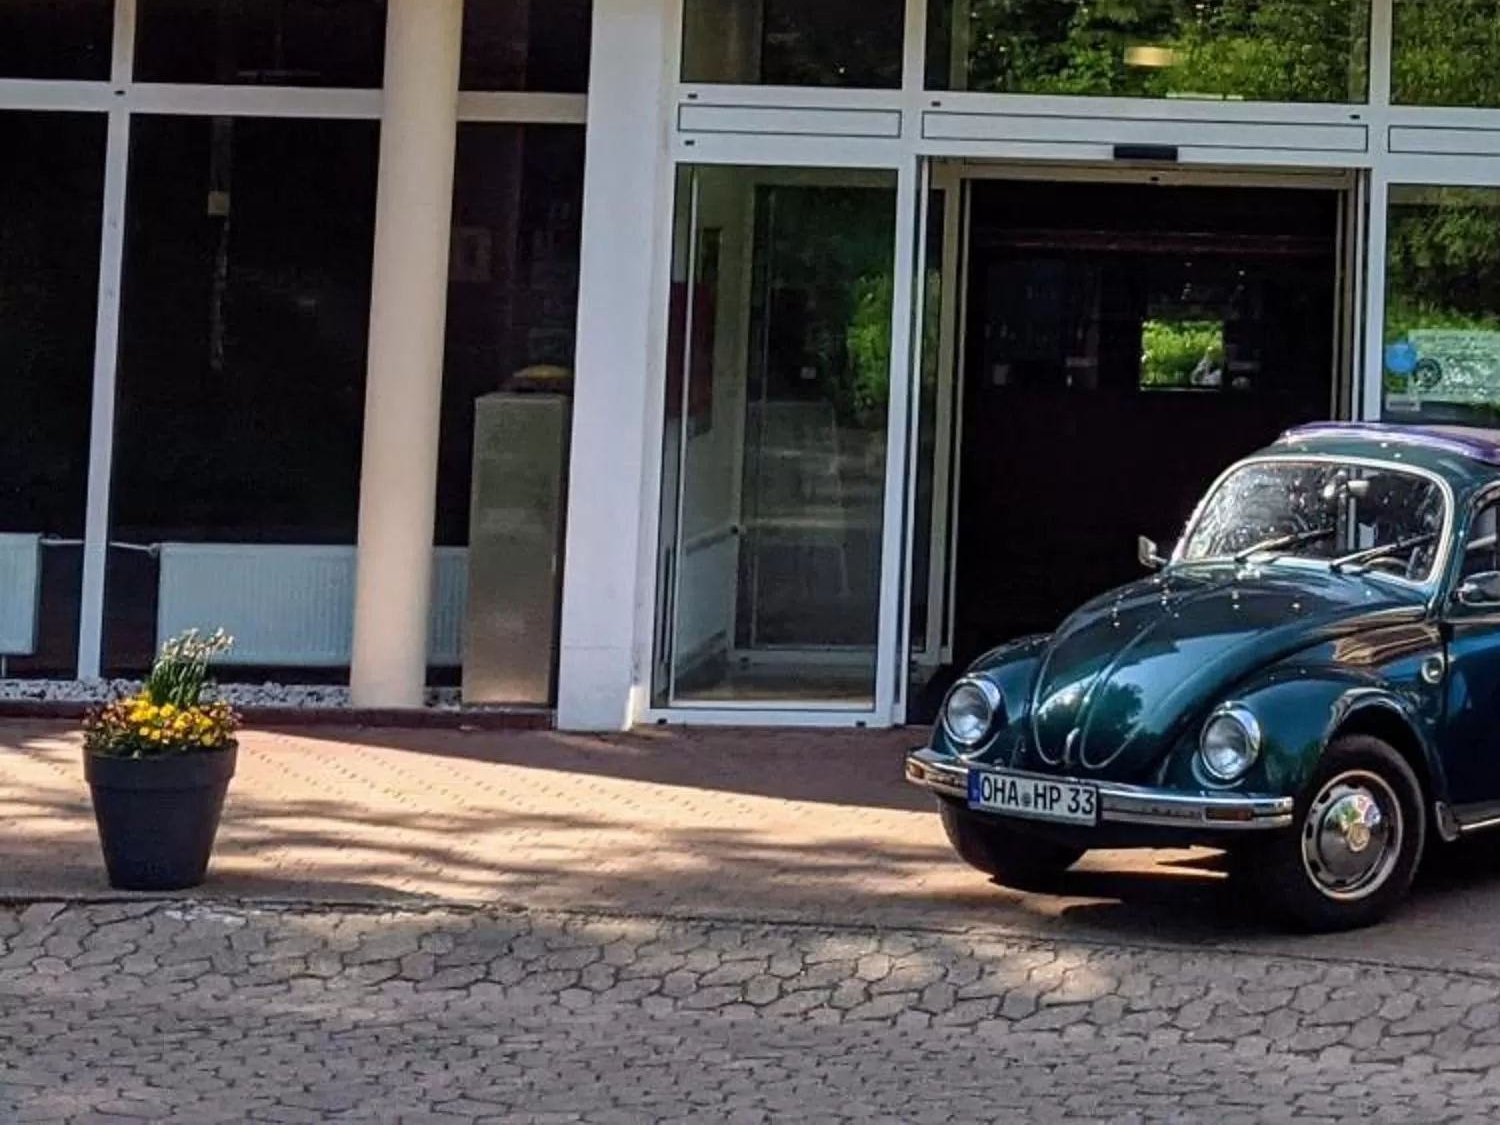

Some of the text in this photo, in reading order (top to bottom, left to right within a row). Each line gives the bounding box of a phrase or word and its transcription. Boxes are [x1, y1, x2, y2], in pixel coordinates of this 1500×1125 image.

[982, 776, 1094, 815] OHA HP 33
